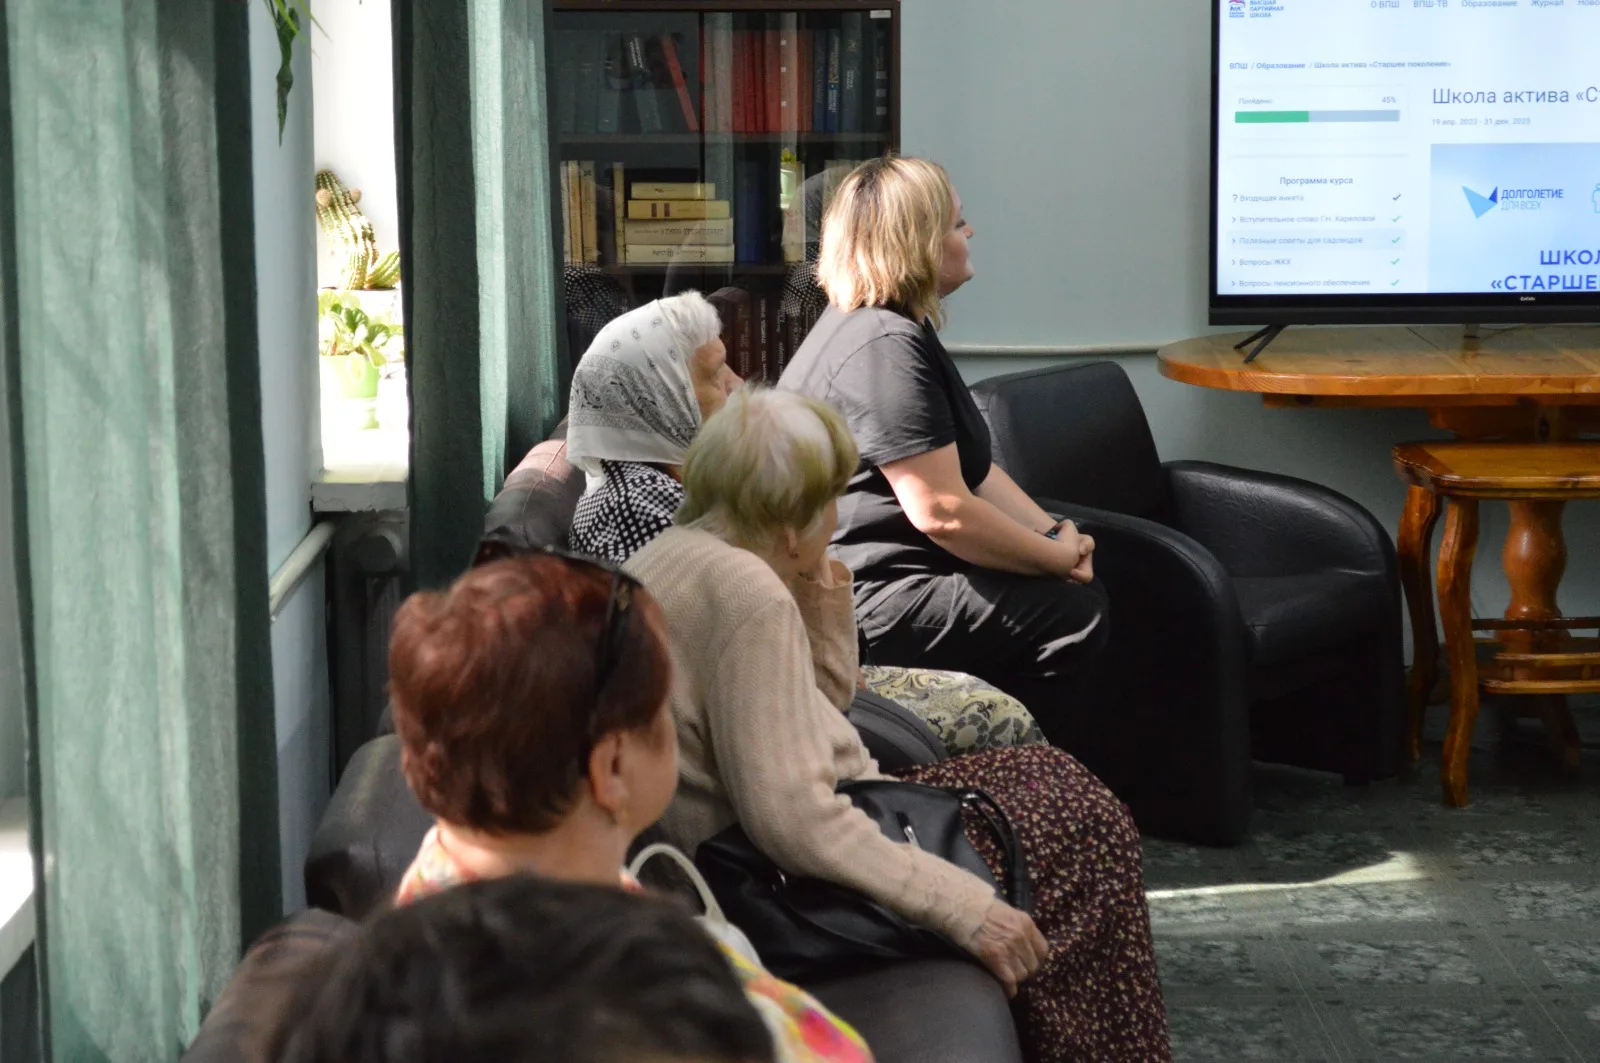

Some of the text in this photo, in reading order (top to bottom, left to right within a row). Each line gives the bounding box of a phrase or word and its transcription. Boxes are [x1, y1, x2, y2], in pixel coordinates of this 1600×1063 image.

[1413, 0, 1448, 8] ВПШ-ТВ
[1256, 62, 1306, 70] Образование
[1408, 60, 1451, 68] поколение»
[1433, 86, 1600, 104] Школа актива «С
[1432, 118, 1440, 126] 19
[1460, 118, 1478, 126] 2023
[1512, 117, 1531, 125] 2023
[1280, 176, 1354, 186] Программа курса
[1501, 188, 1564, 200] ДОЛГОЛЕТИЕ
[1501, 201, 1541, 211] ДЛЯ ВСЕХ
[1240, 215, 1295, 224] Вступительное
[1239, 258, 1292, 267] Вопросы ЖКХ
[1239, 279, 1271, 288] Вопросы
[1491, 275, 1598, 290] «СТАРШЕ
